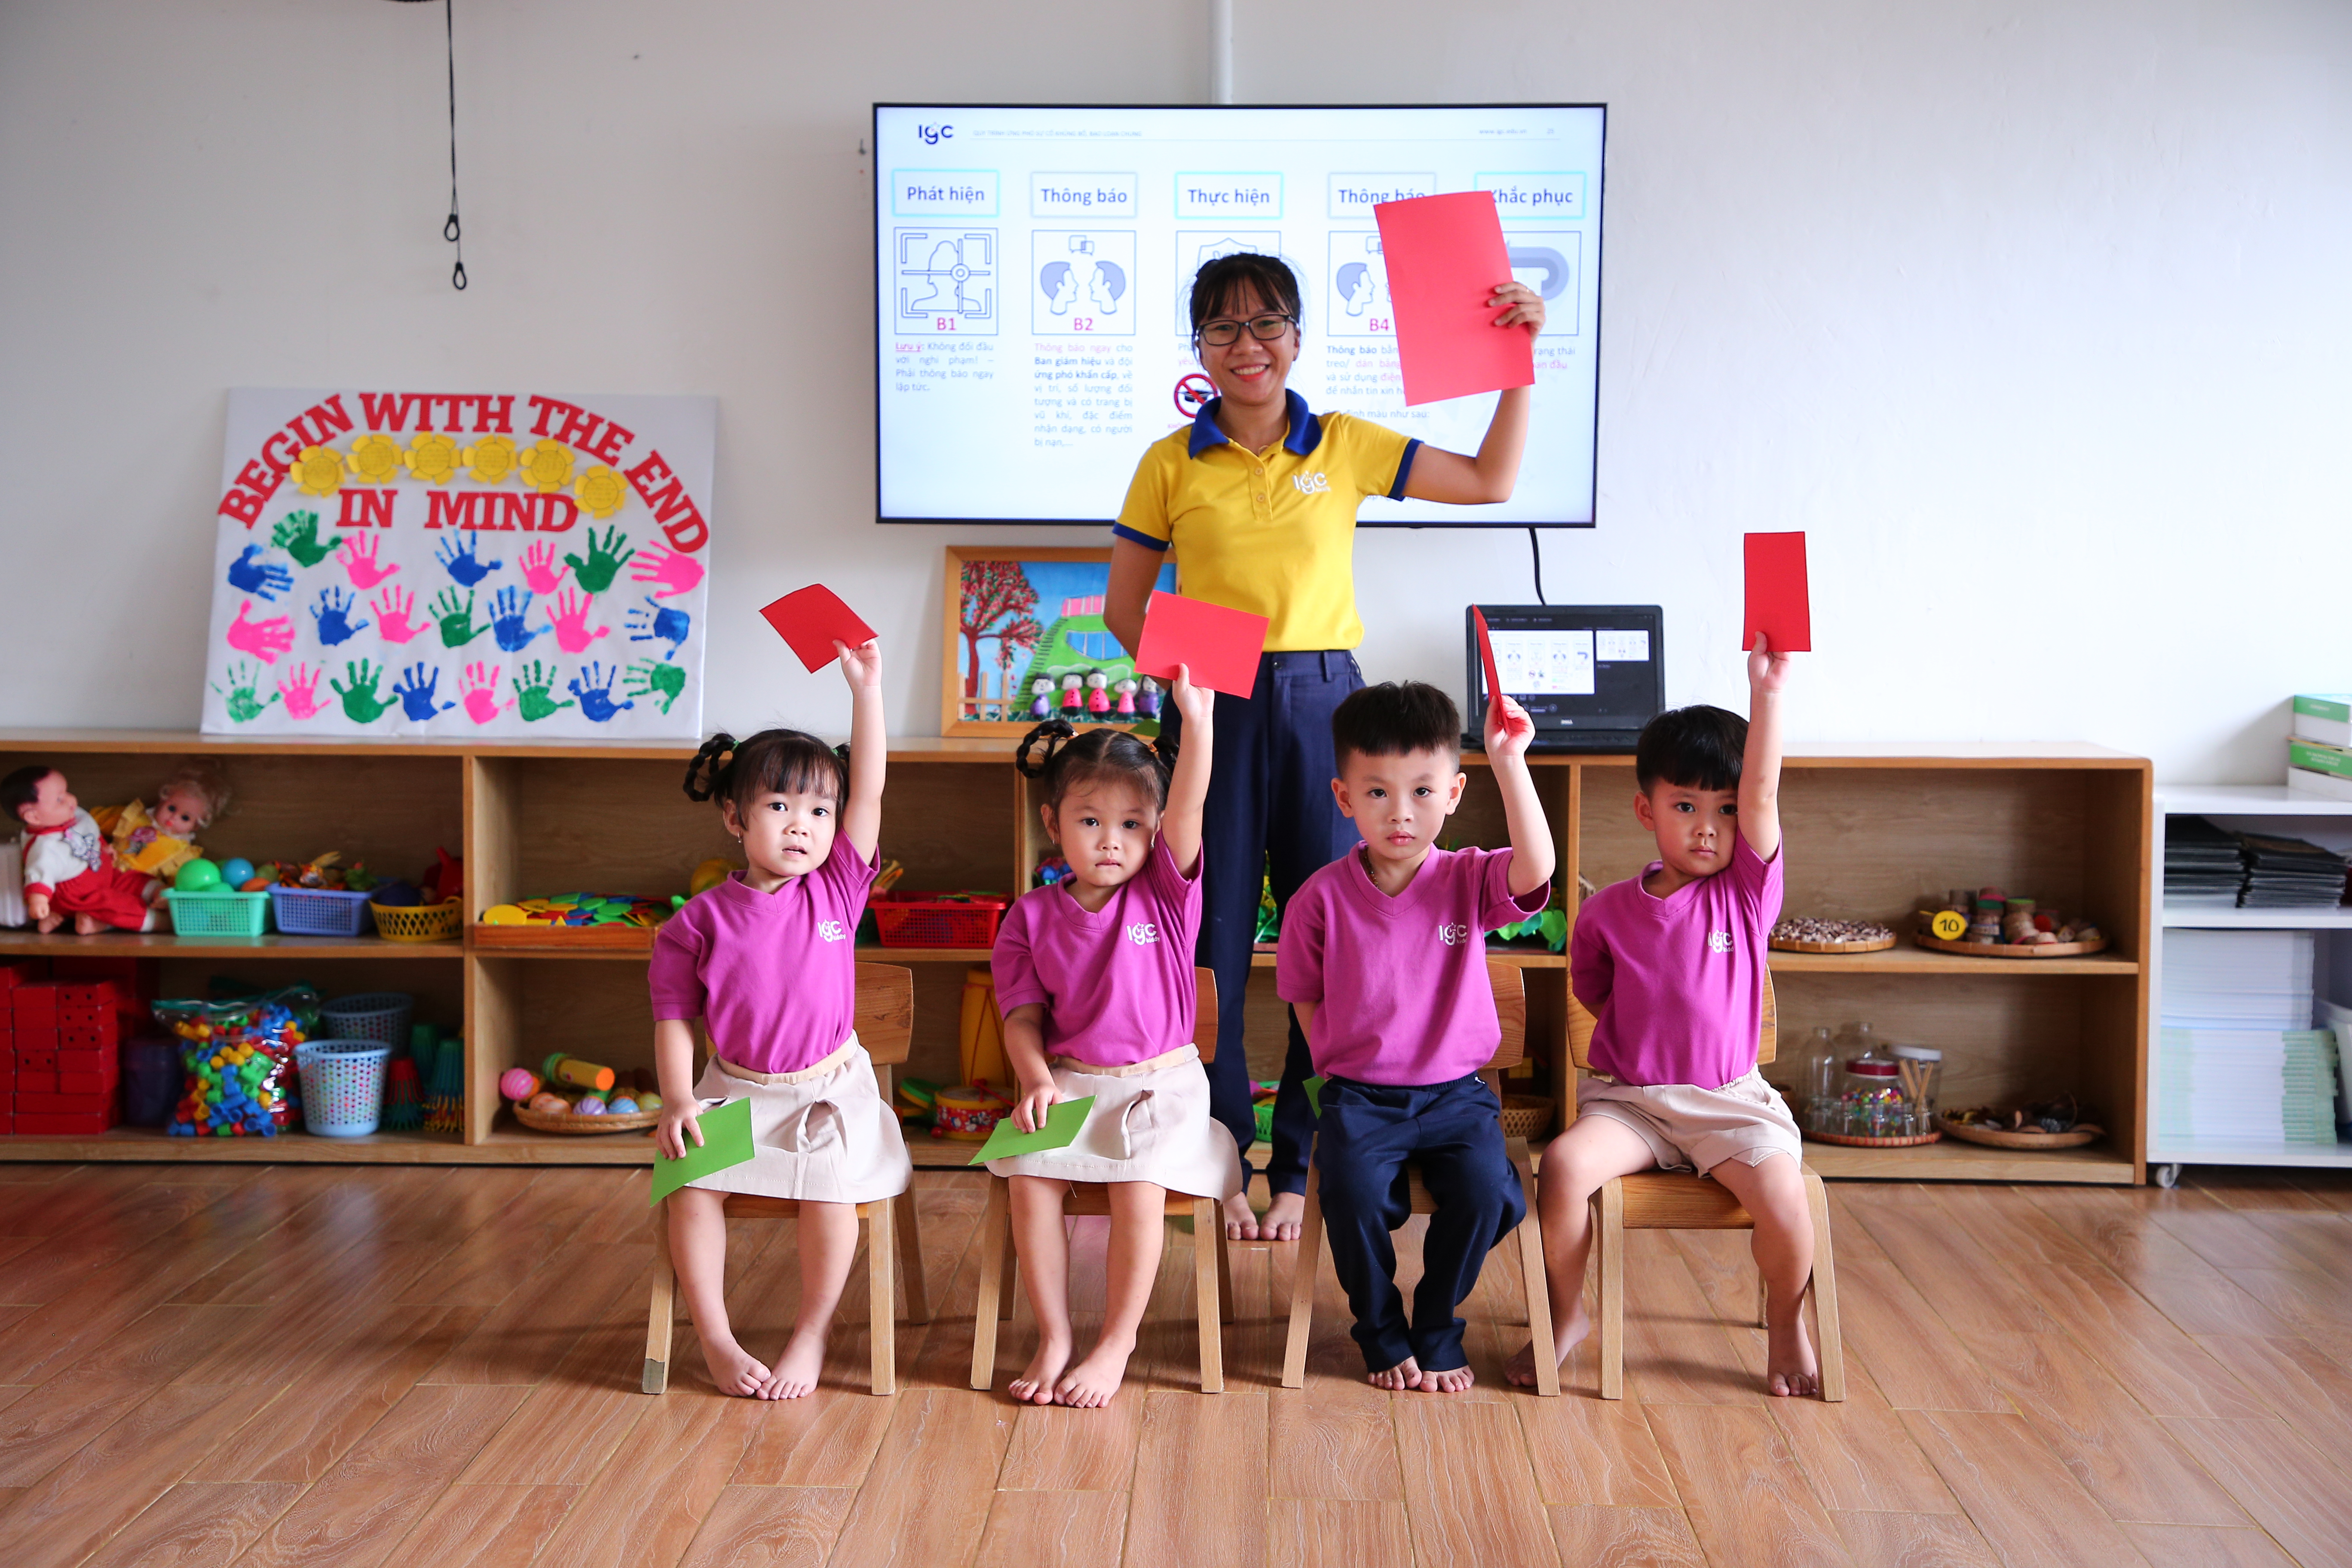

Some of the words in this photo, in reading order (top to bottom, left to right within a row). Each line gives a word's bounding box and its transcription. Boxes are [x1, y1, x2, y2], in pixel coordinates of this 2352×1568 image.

[907, 186, 944, 201] Phát
[950, 186, 985, 204] hiện
[1041, 187, 1092, 206] Thông
[1097, 187, 1127, 202] báo
[1187, 188, 1229, 206] Thực
[1235, 188, 1269, 206] hiện
[1338, 188, 1389, 203] Thông
[1532, 187, 1573, 206] phục
[937, 317, 956, 330] B1
[1074, 318, 1093, 331] B2
[1370, 318, 1389, 331] B4
[927, 341, 956, 352] Không
[1035, 343, 1063, 352] Thông
[1068, 343, 1085, 352] báo
[1090, 344, 1112, 353] ngay
[1116, 343, 1133, 352] cho
[1326, 345, 1356, 356] Thông
[1359, 345, 1378, 354] báo
[919, 355, 940, 365] nghi
[1035, 356, 1052, 364] Ban
[1055, 356, 1078, 366] giám
[1081, 356, 1102, 366] hiệu
[1104, 356, 1115, 365] và
[920, 368, 946, 379] thông
[951, 368, 968, 377] báo
[972, 370, 994, 379] ngay
[1034, 370, 1053, 380] ứng
[1055, 370, 1073, 380] phó
[1326, 372, 1336, 381] và
[1354, 373, 1378, 383] dụng
[1084, 383, 1112, 394] lượng
[1366, 386, 1378, 395] tin
[1381, 386, 1394, 395] xin
[1034, 398, 1063, 407] tượng
[1081, 397, 1092, 406] có
[1096, 399, 1120, 407] trang
[218, 393, 354, 529] BEGIN
[358, 392, 515, 433] WITH
[528, 395, 635, 467] THE
[623, 450, 710, 553] END
[336, 489, 398, 528] IN
[424, 490, 579, 532] MIND
[1939, 919, 1959, 932] 10
